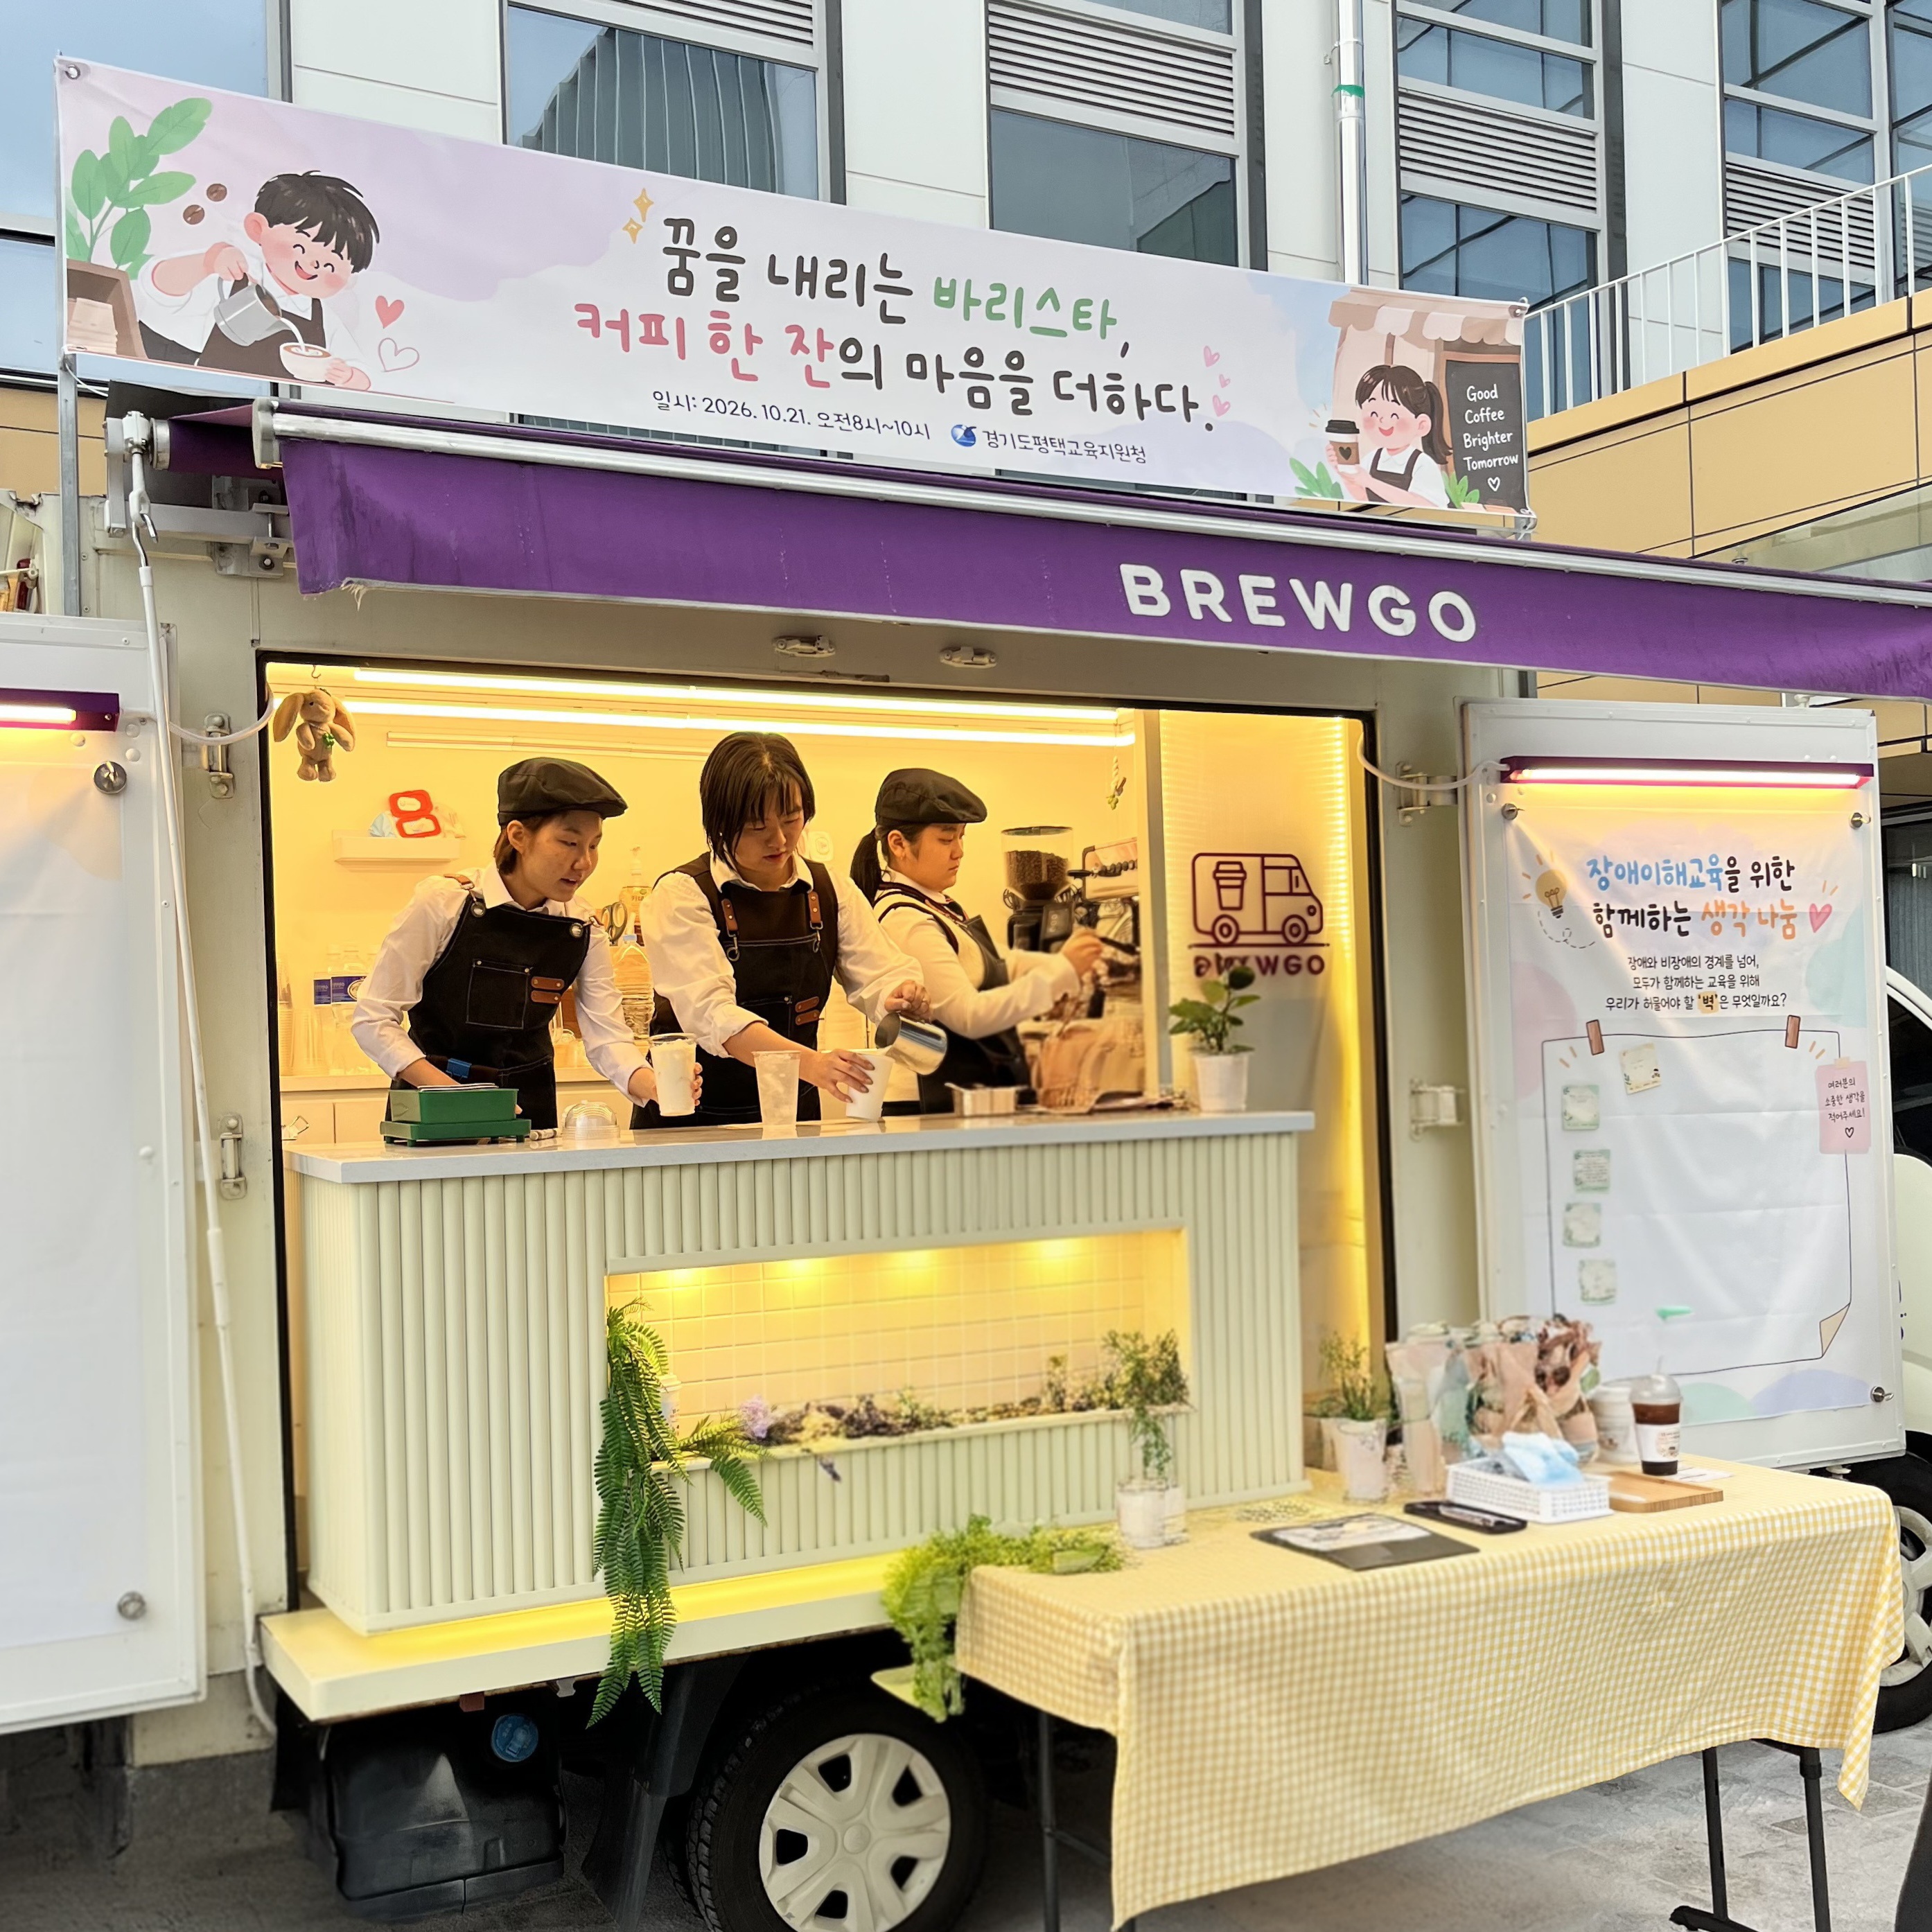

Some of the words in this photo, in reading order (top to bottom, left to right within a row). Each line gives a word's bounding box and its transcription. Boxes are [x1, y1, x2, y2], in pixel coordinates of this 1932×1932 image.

[662, 218, 746, 302] 꿈을
[768, 253, 913, 324] 내리는
[934, 276, 1130, 358] 바리스타,
[574, 304, 686, 360] 커피
[708, 310, 763, 382] 한
[785, 324, 882, 390] 잔의
[906, 346, 1034, 415] 마음을
[1053, 370, 1214, 432] 더하다.
[1466, 383, 1498, 402] Good
[1464, 407, 1504, 423] Coffee
[982, 430, 1146, 464] 경기도평택교육지원청
[1463, 431, 1513, 451] Brighter
[1462, 454, 1518, 471] Tomorrow
[1119, 563, 1476, 642] BREWGO
[1586, 853, 1741, 893] 장애이해교육을
[1750, 856, 1795, 891] 위한
[1593, 900, 1692, 938] 함께하는
[1701, 899, 1750, 937] 생각
[1757, 898, 1798, 940] 나눔
[1627, 956, 1657, 971] 장애와
[1660, 956, 1701, 970] 비장애의
[1704, 954, 1734, 969] 경계를
[1737, 954, 1759, 969] 넘어,
[1633, 976, 1660, 990] 모두가
[1663, 975, 1704, 990] 함께하는
[1707, 974, 1736, 989] 교육을
[1739, 974, 1759, 987] 위해
[1606, 996, 1640, 1011] 우리가
[1643, 996, 1680, 1012] 허물어야
[1684, 995, 1694, 1010] 할
[1732, 992, 1787, 1008] 무엇일까요?
[1827, 1077, 1856, 1089] 여러분의
[1825, 1094, 1843, 1107] 소중한
[1845, 1090, 1865, 1104] 생각을
